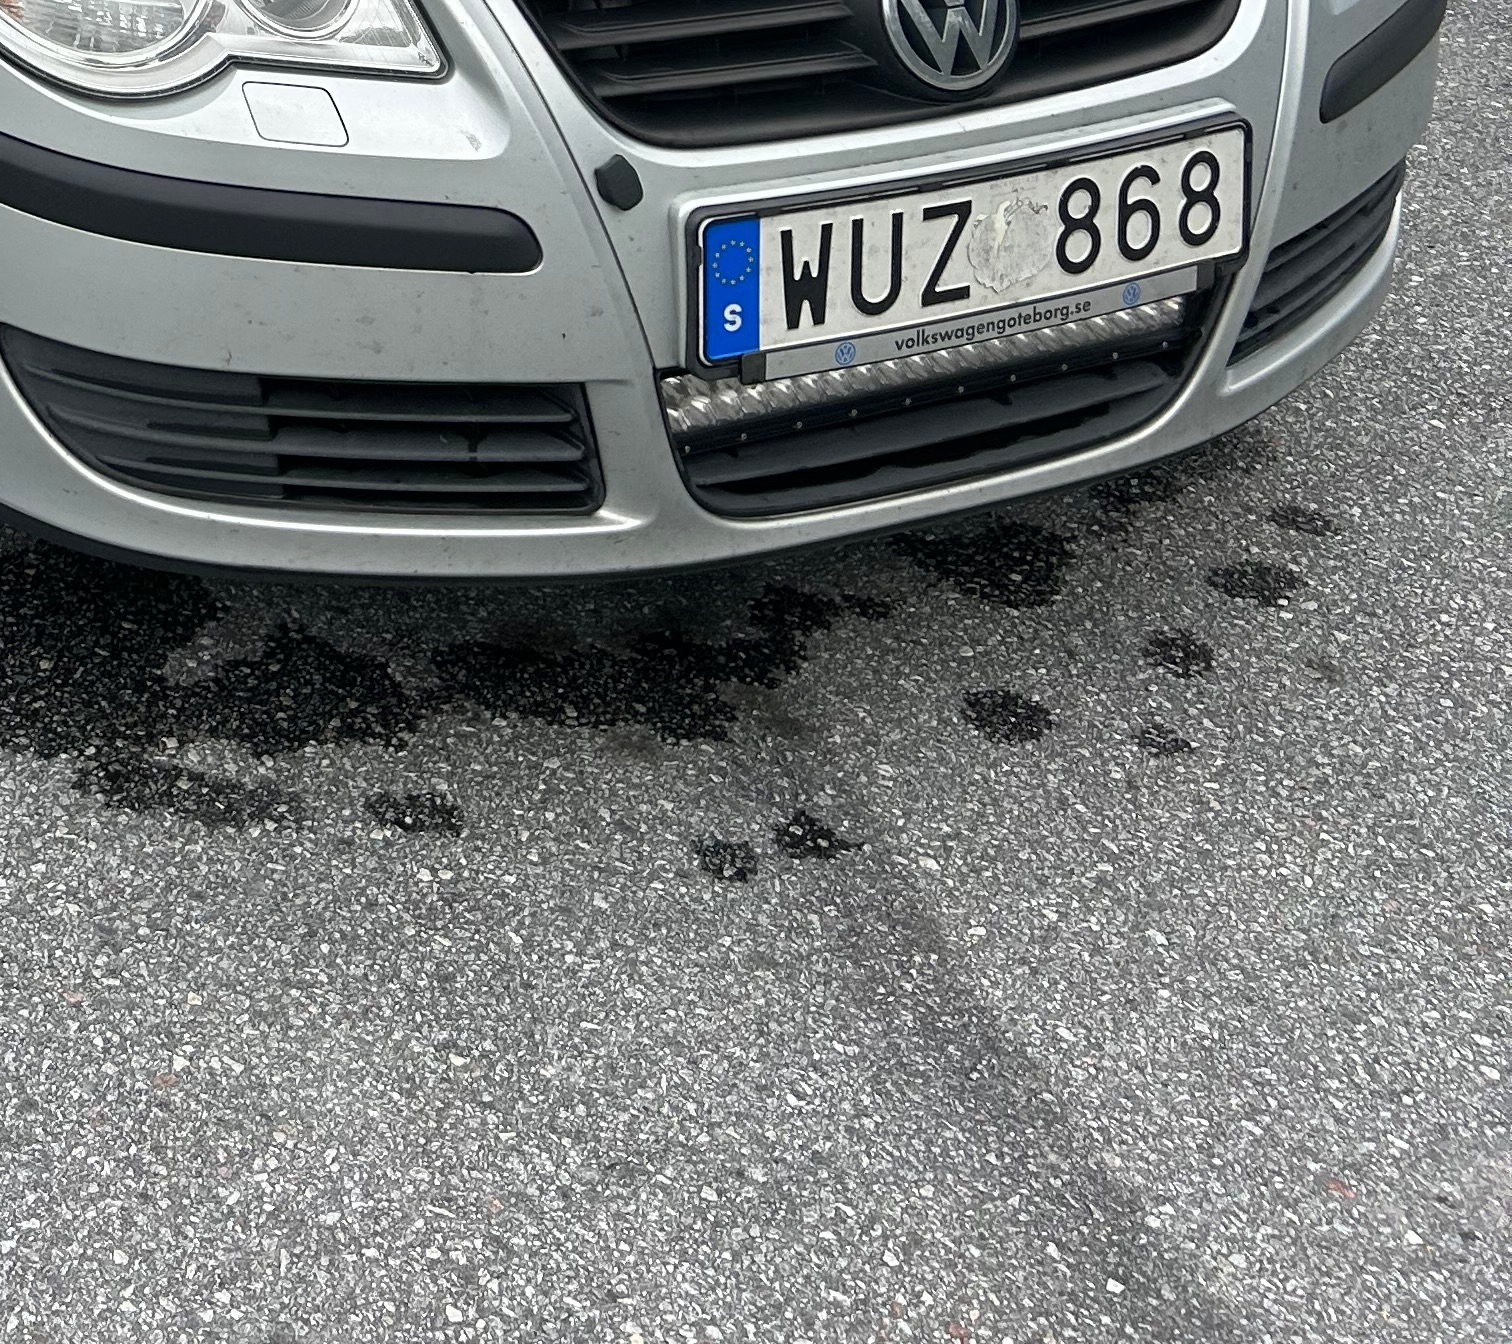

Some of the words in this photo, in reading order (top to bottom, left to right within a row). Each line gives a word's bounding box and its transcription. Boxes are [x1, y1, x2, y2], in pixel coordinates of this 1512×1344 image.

[780, 199, 973, 330] WUZ
[1056, 150, 1221, 274] 868
[722, 302, 743, 332] S
[894, 299, 1092, 352] volkswagengoteborg.se
